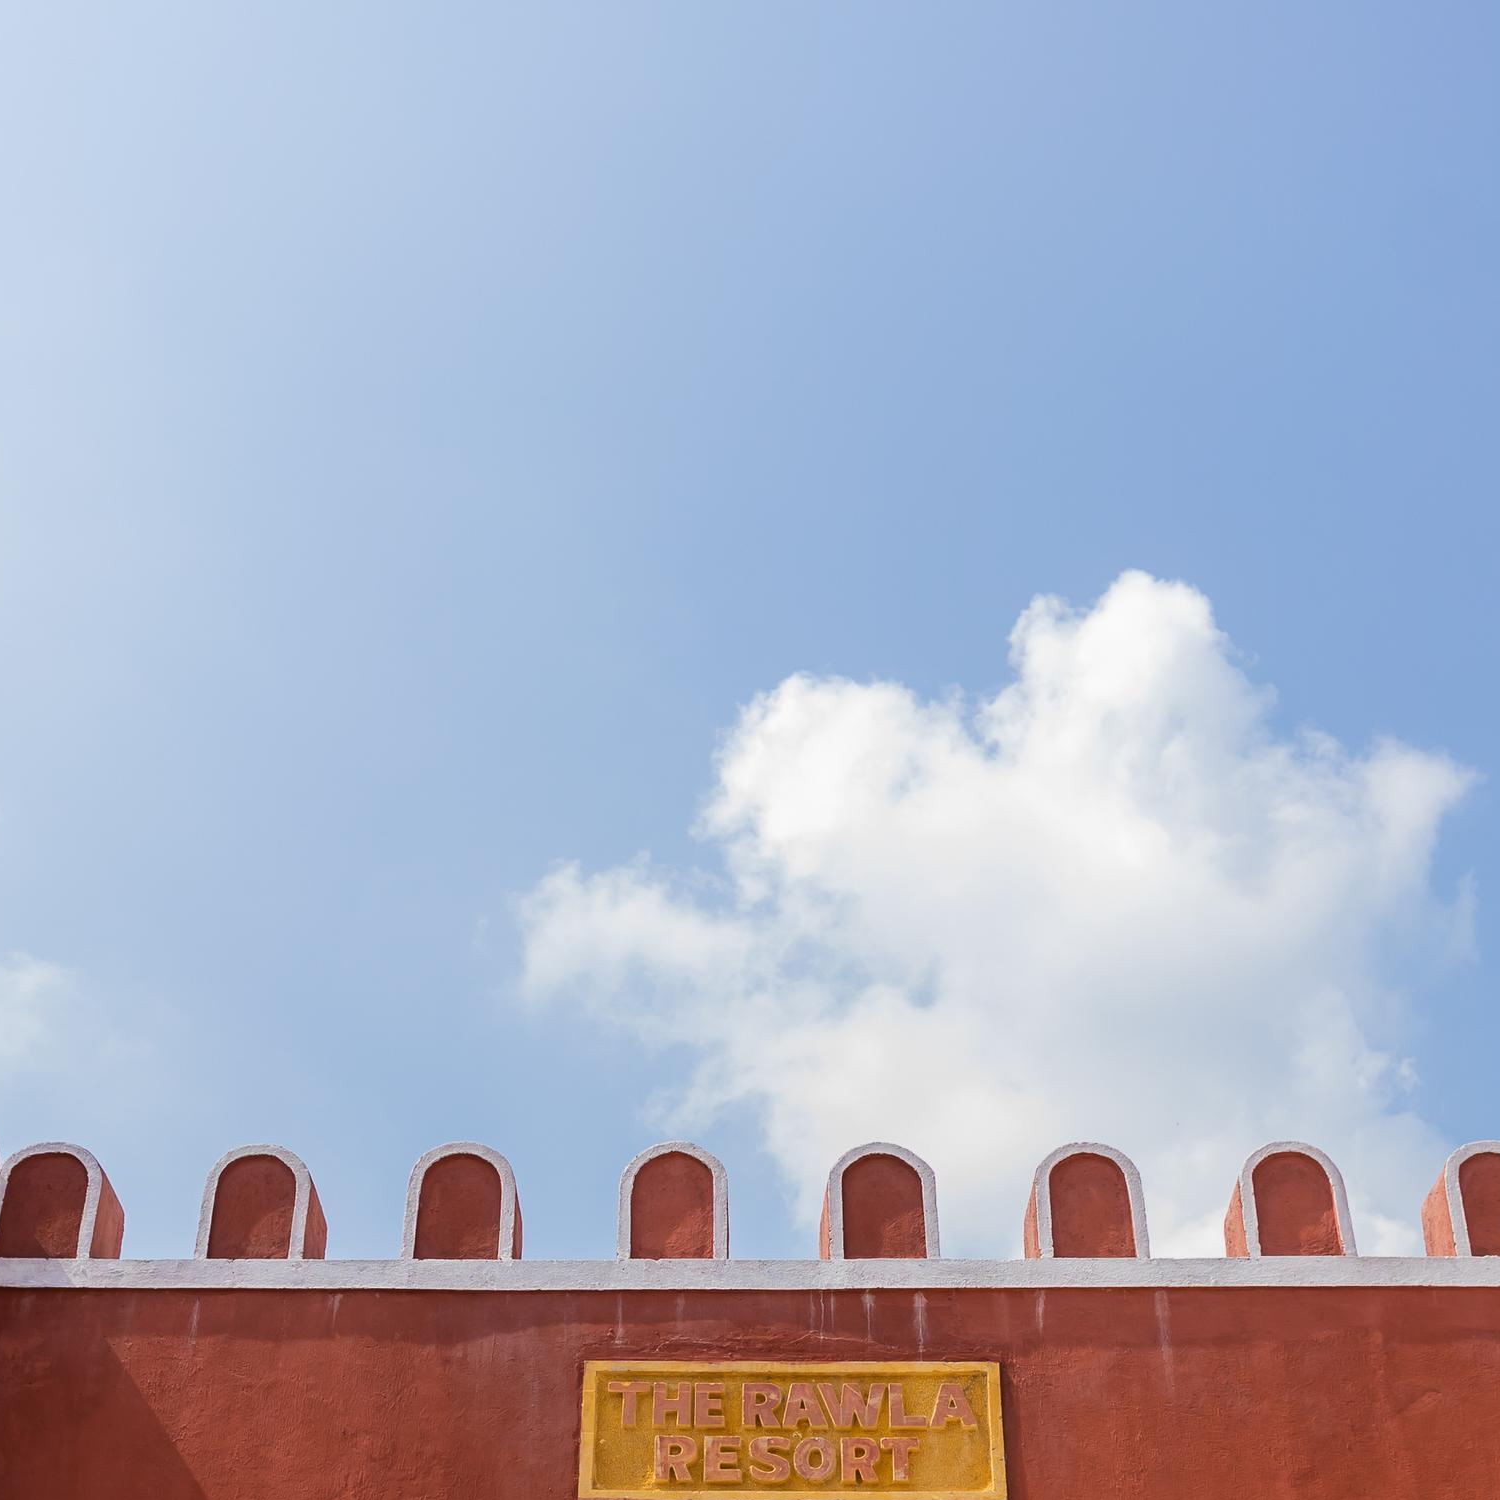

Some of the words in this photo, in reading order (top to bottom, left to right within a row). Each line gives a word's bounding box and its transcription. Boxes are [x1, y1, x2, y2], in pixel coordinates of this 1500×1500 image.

[608, 1381, 726, 1430] THE
[740, 1382, 978, 1430] RAWLA
[654, 1434, 920, 1484] RESORT
